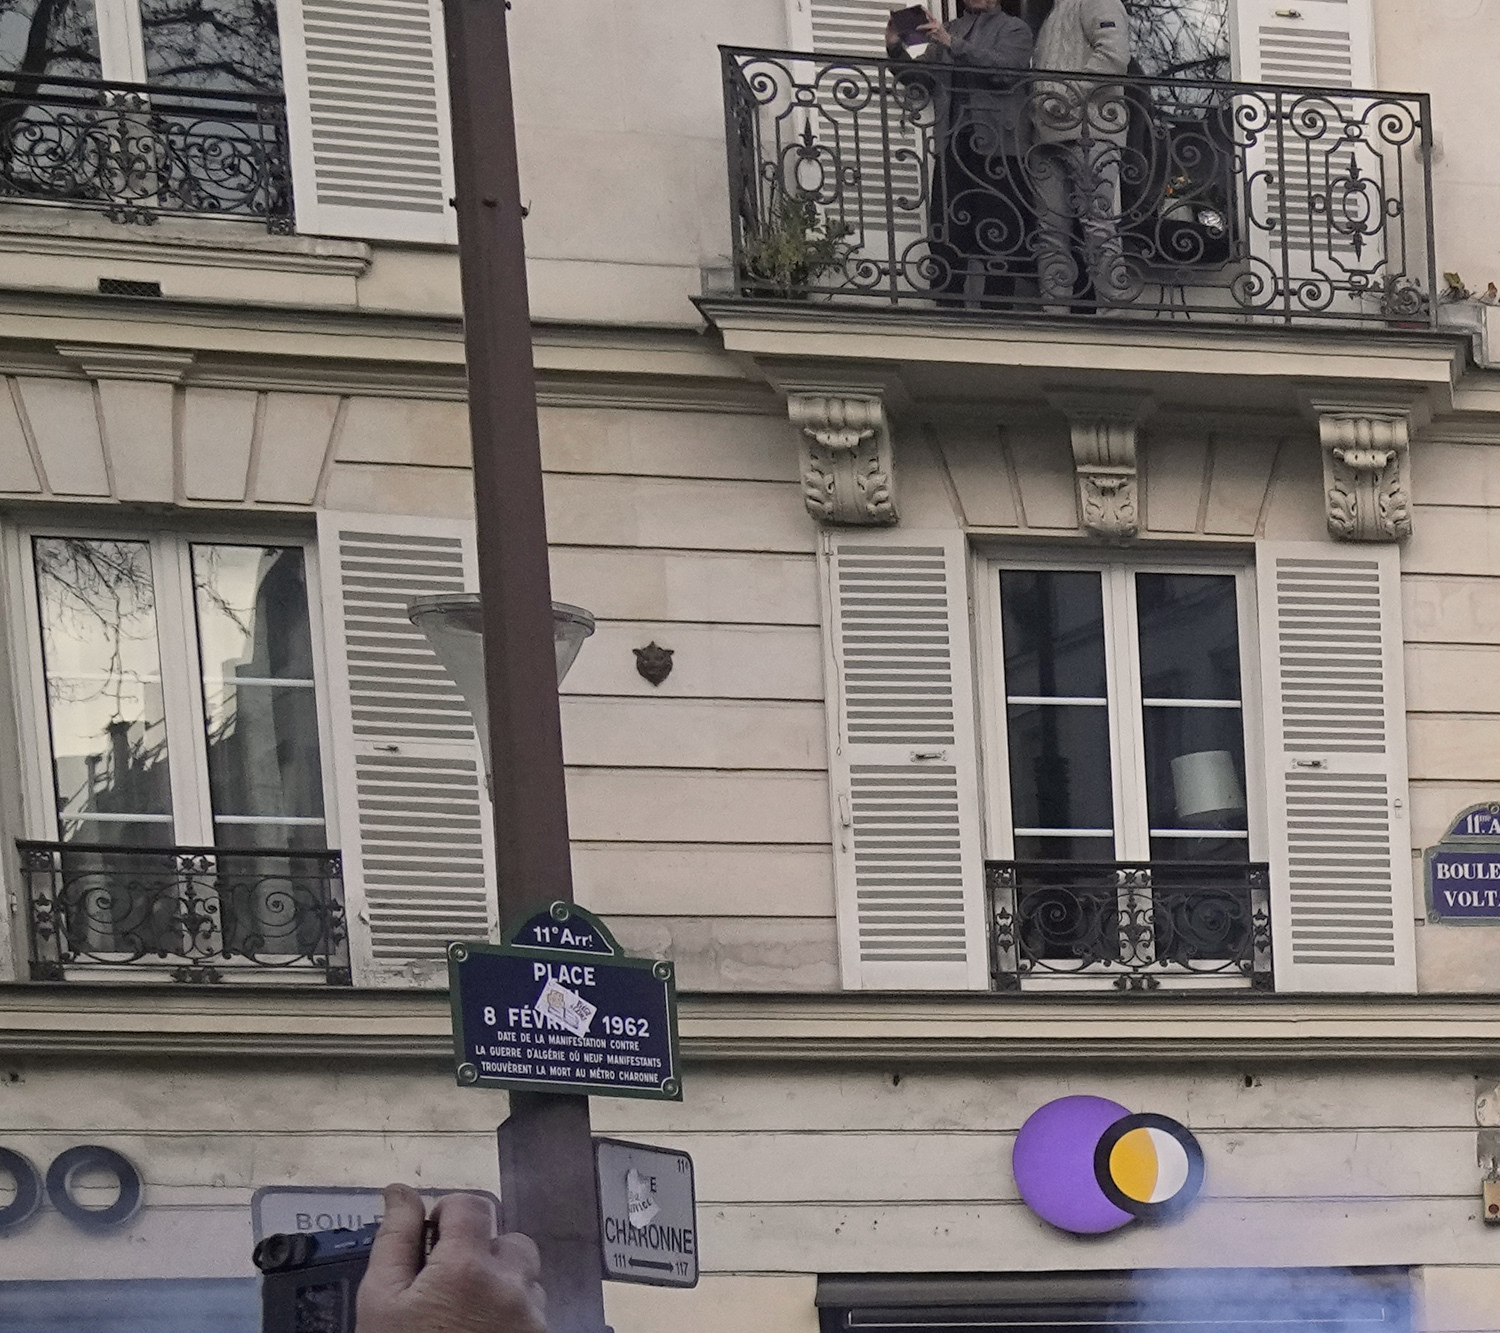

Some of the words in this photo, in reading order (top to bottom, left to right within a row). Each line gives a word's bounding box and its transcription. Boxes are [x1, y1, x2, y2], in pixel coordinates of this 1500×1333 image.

[533, 963, 596, 986] PLACE
[483, 1006, 497, 1025] 8
[602, 1015, 650, 1038] 1962
[497, 1031, 518, 1043] DATE
[521, 1033, 531, 1044] DE
[535, 1033, 545, 1045] LA
[548, 1034, 607, 1049] MANIFESTATION
[610, 1038, 640, 1051] CONTRE
[475, 1045, 486, 1055] LA
[490, 1046, 522, 1058] GUERRE
[584, 1052, 604, 1064] NEUF
[607, 1054, 662, 1068] MANIFESTANTS
[481, 1060, 533, 1076] TROUVÈRENT
[536, 1065, 547, 1076] LA
[550, 1066, 572, 1078] MORT
[576, 1067, 587, 1079] AU
[590, 1065, 616, 1081] MÉTRO
[619, 1071, 660, 1084] CHARONNE
[605, 1217, 694, 1254] CHARONNE
[614, 1253, 627, 1268] 111
[675, 1262, 689, 1277] 117
